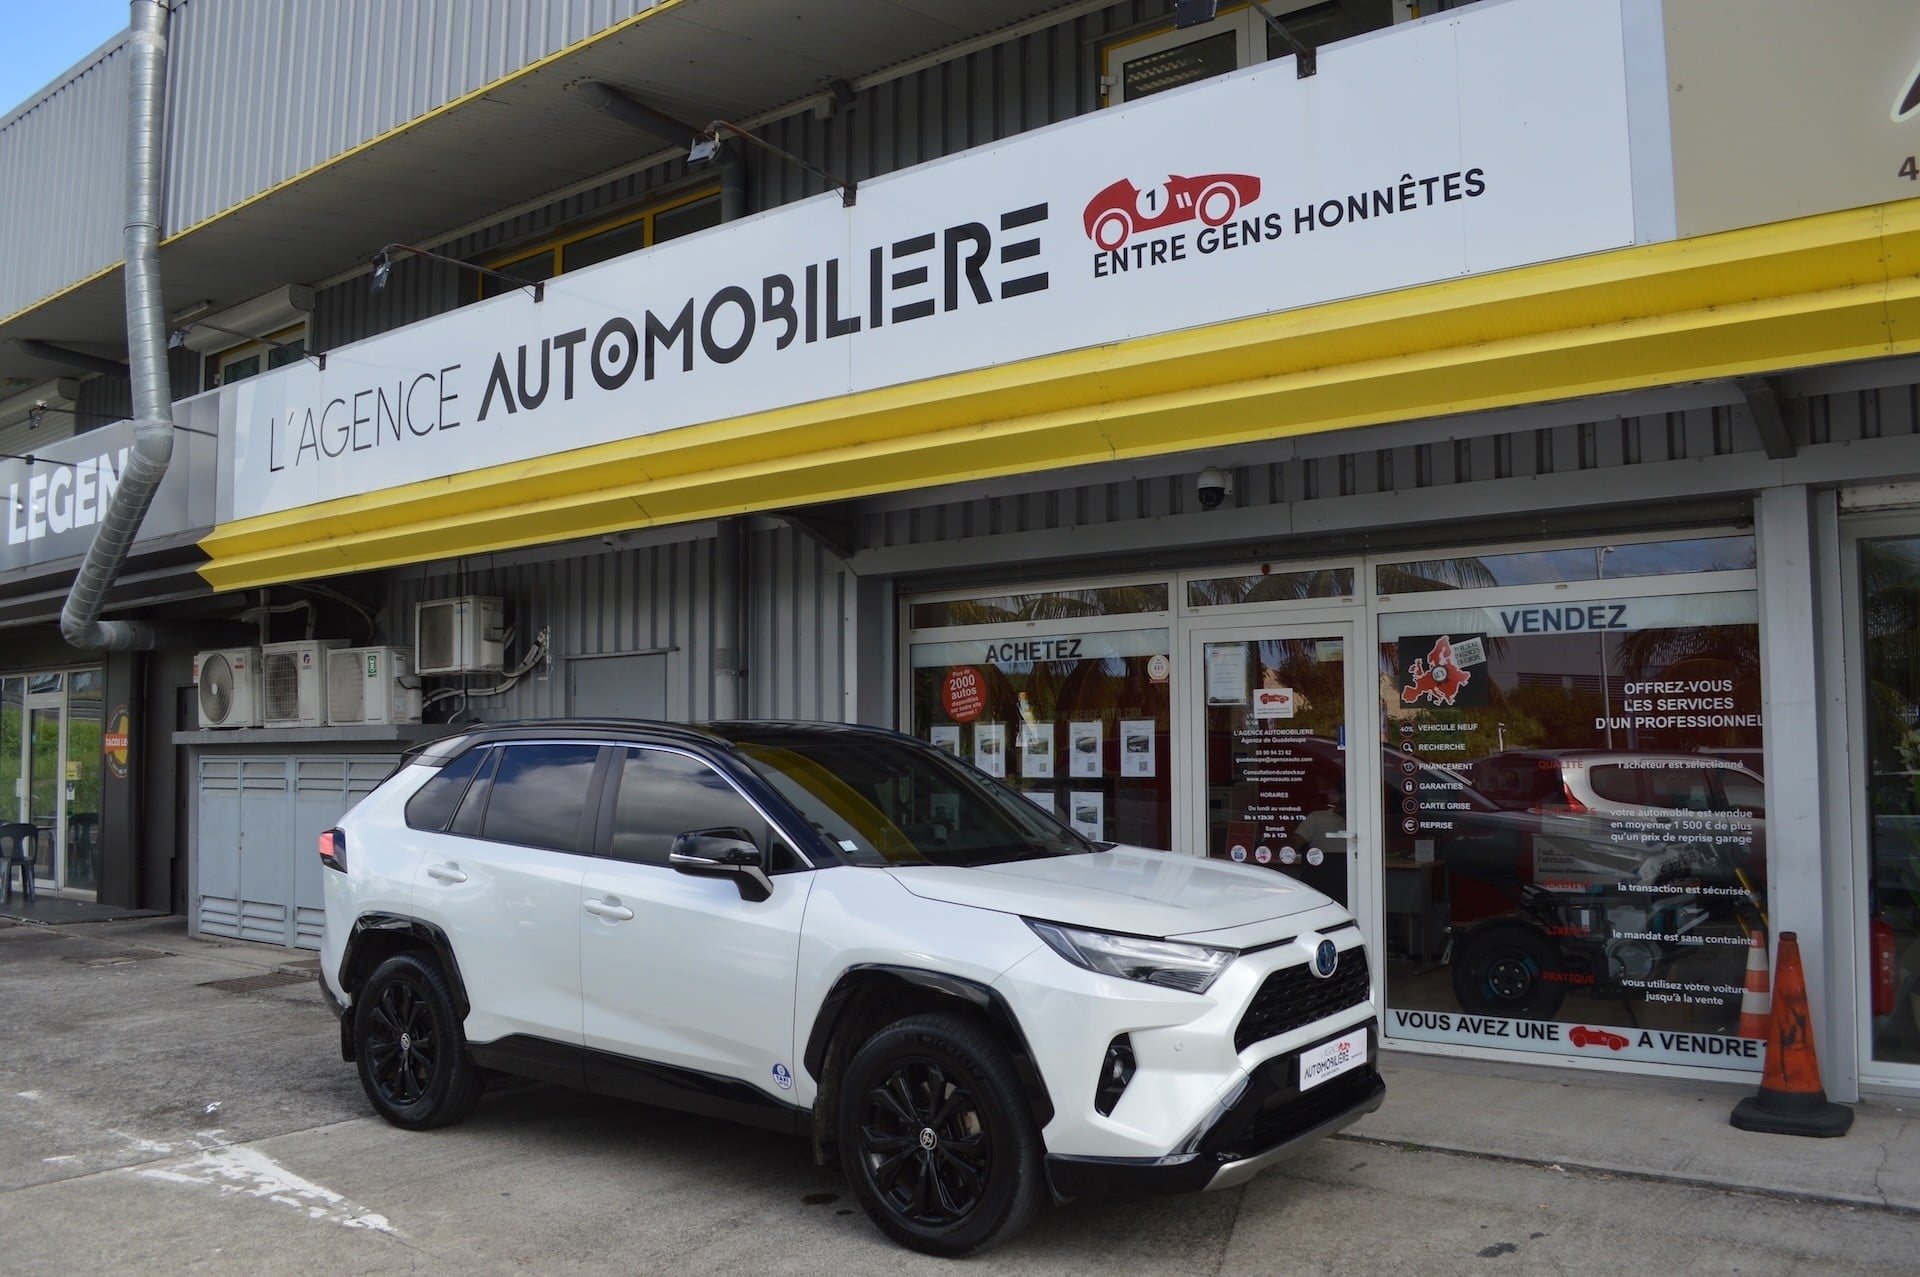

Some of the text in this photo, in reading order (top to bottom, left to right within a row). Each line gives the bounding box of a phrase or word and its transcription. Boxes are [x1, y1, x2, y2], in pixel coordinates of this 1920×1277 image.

[1145, 189, 1156, 211] 1
[1094, 167, 1486, 278] ENTRE GENS HONNÊTES
[270, 202, 1048, 472] L'AGENCE AUTOMOBILIERE
[8, 446, 134, 545] LEGEN
[1500, 604, 1627, 633] VENDEZ
[985, 639, 1082, 663] ACHETEZ
[949, 674, 976, 691] 2000
[1624, 680, 1733, 694] OFFREZ-VOUS
[951, 687, 977, 700] autos
[1624, 697, 1734, 712] LES SERVICES
[1418, 724, 1456, 732] VEHICULE
[1457, 723, 1478, 731] NEUF
[1595, 715, 1763, 729] D'UN PROFESSIONNEL
[1418, 743, 1466, 751] RECHERCHE
[1618, 759, 1744, 769] l'acheteur est sélectionné
[1419, 782, 1464, 790] GARANTIES
[1446, 802, 1471, 810] GRISE
[1610, 808, 1753, 818] votre automobile est vendue
[1420, 821, 1453, 829] REPRISE
[1610, 821, 1752, 832] en moyenne 1 500 € de plus
[1610, 832, 1752, 845] qu'un prix de reprise garage
[1617, 882, 1751, 896] la transaction est sécurisée
[1612, 929, 1758, 946] le mandat est sans contrainte
[1542, 971, 1596, 984] PRATIQUE
[1622, 979, 1748, 994] vous utilisez votre voiture
[1645, 991, 1724, 1005] jusqu'à la vente
[1395, 1011, 1758, 1058] VOUS AVEZ UNE A VENDRE
[1304, 1049, 1349, 1080] AUTOMOBILIERE
